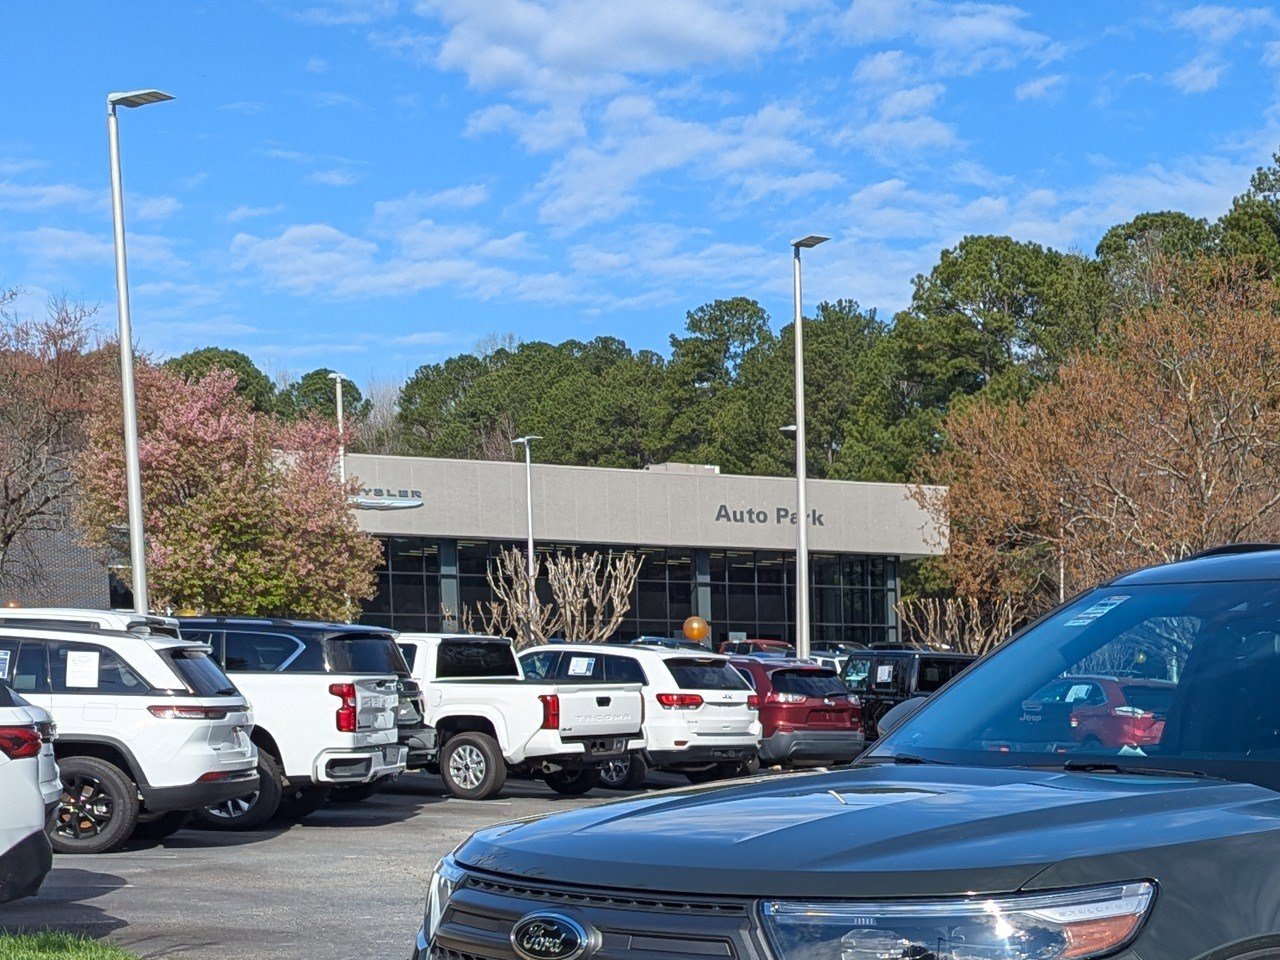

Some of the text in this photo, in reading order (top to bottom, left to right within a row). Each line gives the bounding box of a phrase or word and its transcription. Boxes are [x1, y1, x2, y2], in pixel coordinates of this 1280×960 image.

[362, 487, 423, 499] YSLER
[715, 504, 768, 523] Auto
[519, 922, 567, 953] Ford
